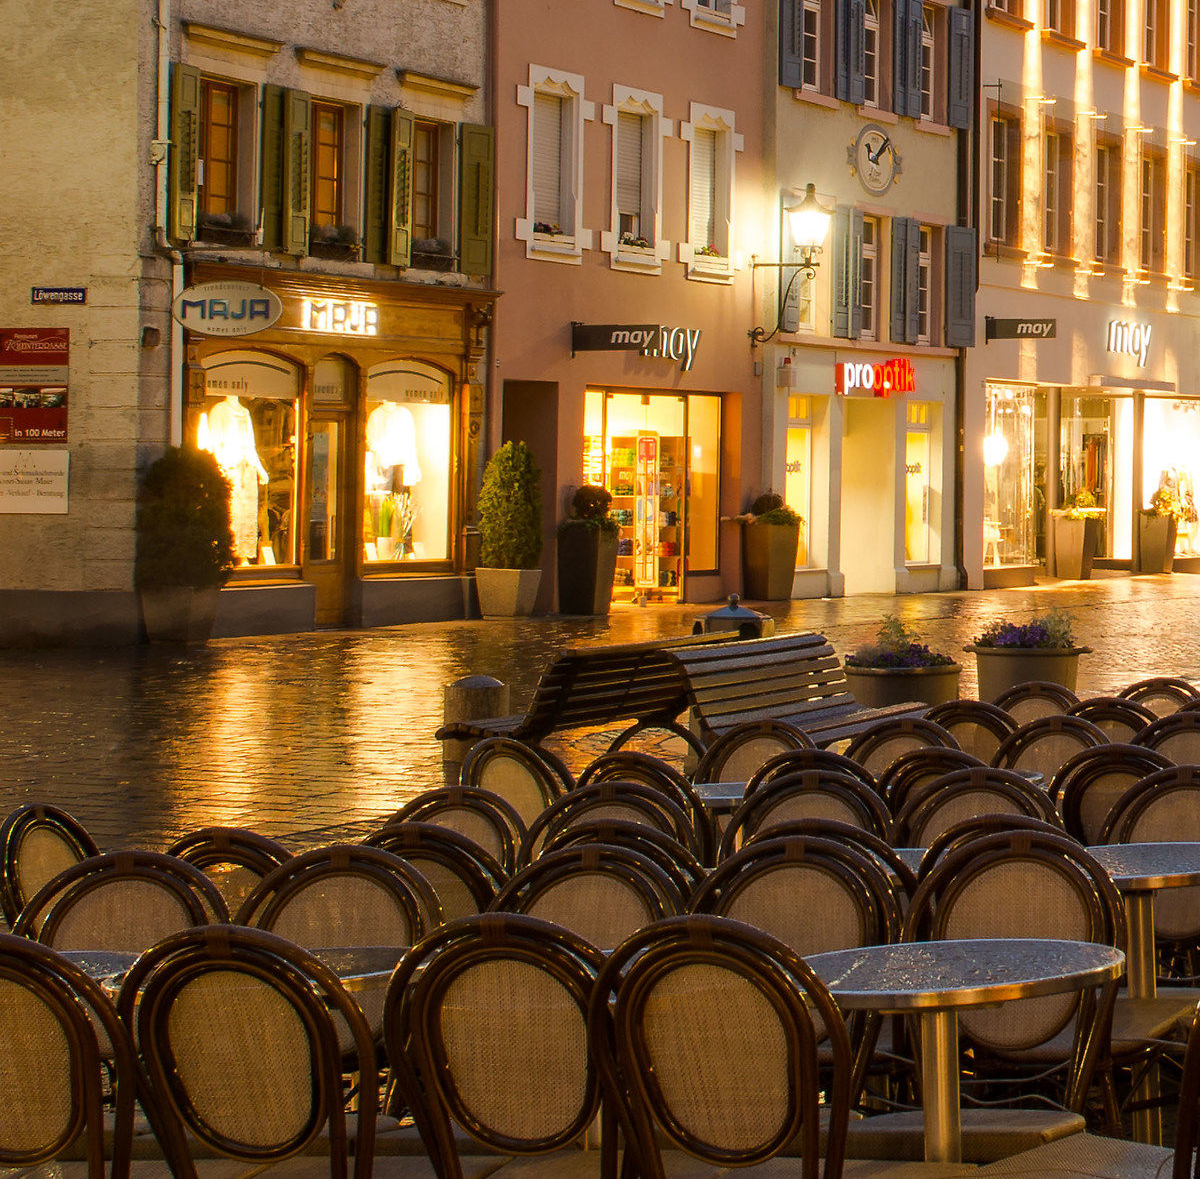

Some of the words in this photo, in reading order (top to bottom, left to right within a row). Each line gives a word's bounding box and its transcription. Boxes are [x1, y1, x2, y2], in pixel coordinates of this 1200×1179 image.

[34, 290, 83, 302] Löwengasse
[181, 299, 270, 320] MAJA
[1016, 322, 1053, 337] may
[610, 330, 655, 348] may
[1107, 319, 1152, 368] may
[206, 380, 229, 390] omen
[25, 428, 40, 437] 100
[41, 428, 66, 437] Meter
